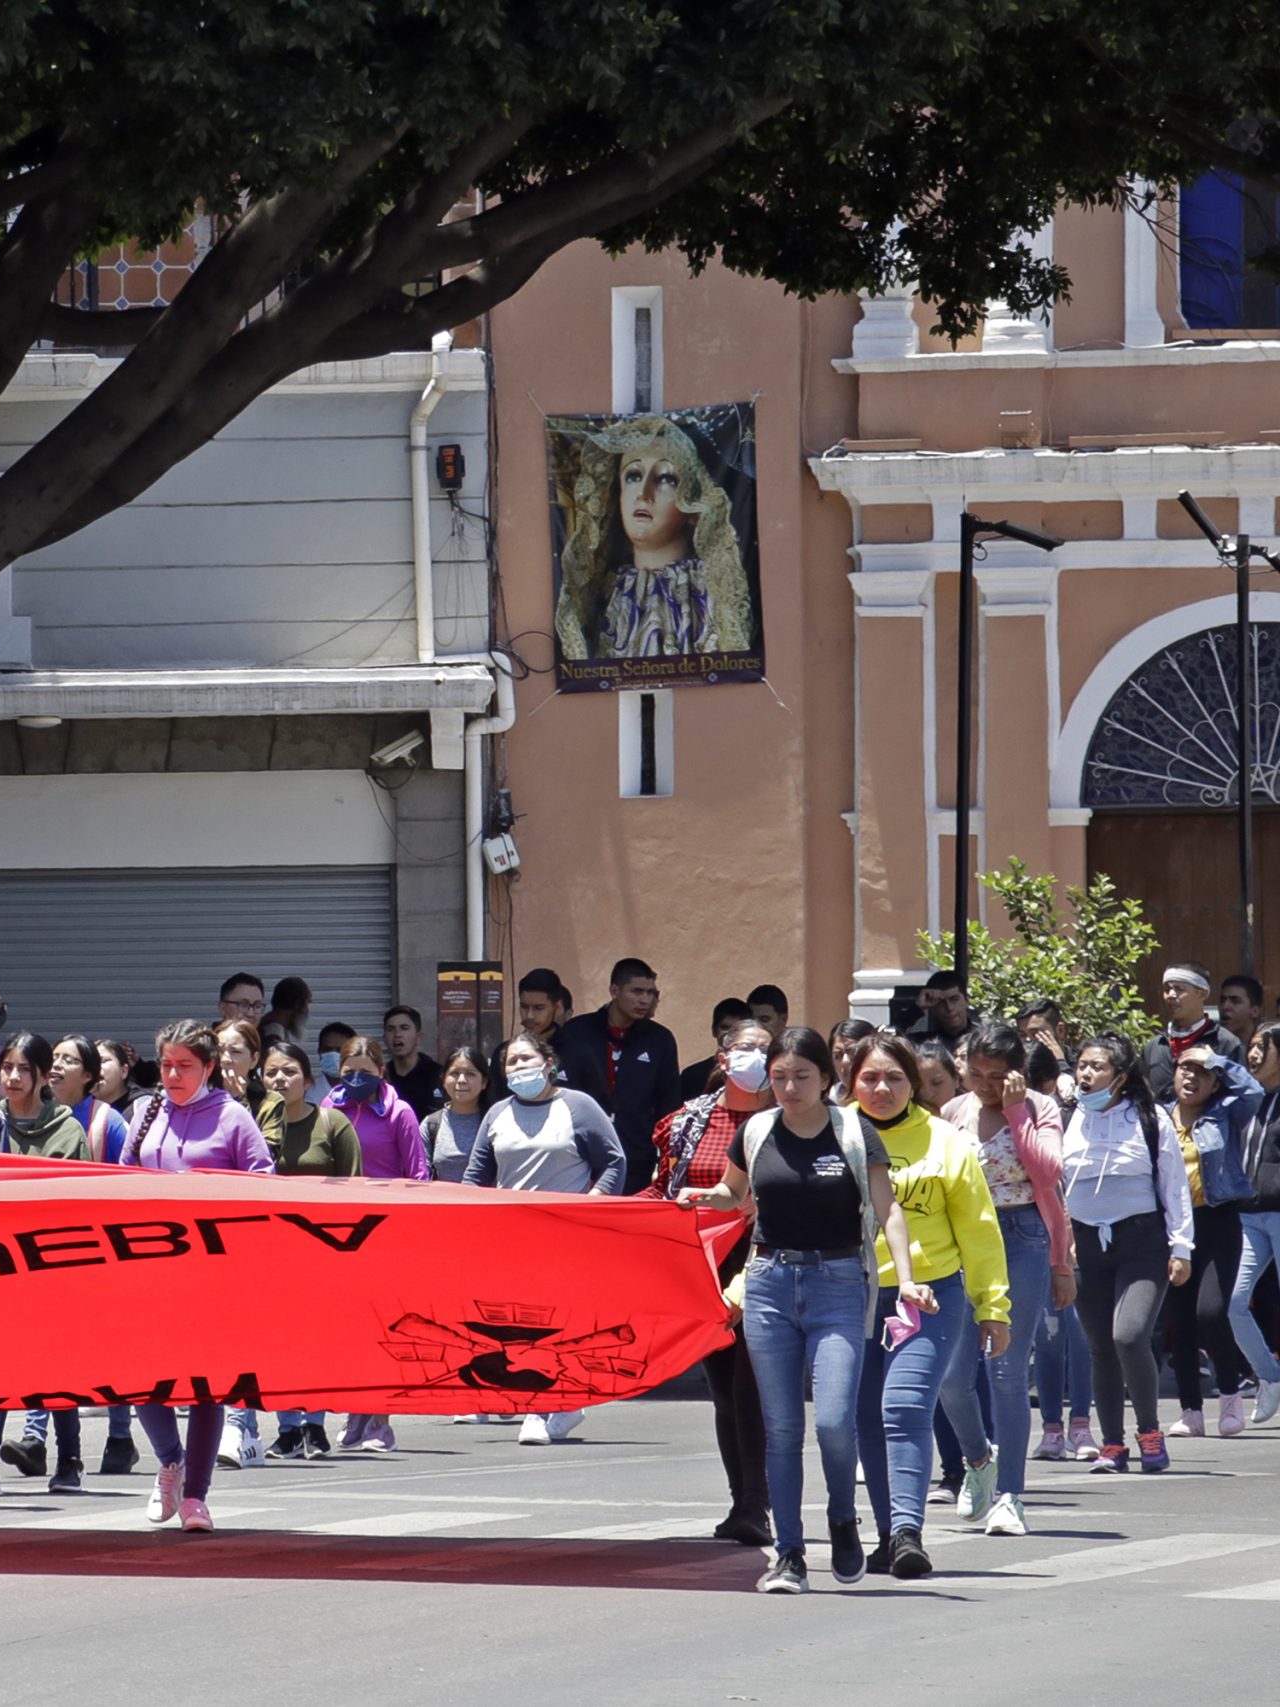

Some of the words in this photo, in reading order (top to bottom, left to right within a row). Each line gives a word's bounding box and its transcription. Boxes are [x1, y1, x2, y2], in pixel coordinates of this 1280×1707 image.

[560, 663, 620, 679] Nuestra
[624, 659, 675, 676] Señora
[678, 658, 697, 674] de
[700, 654, 761, 673] Dolores
